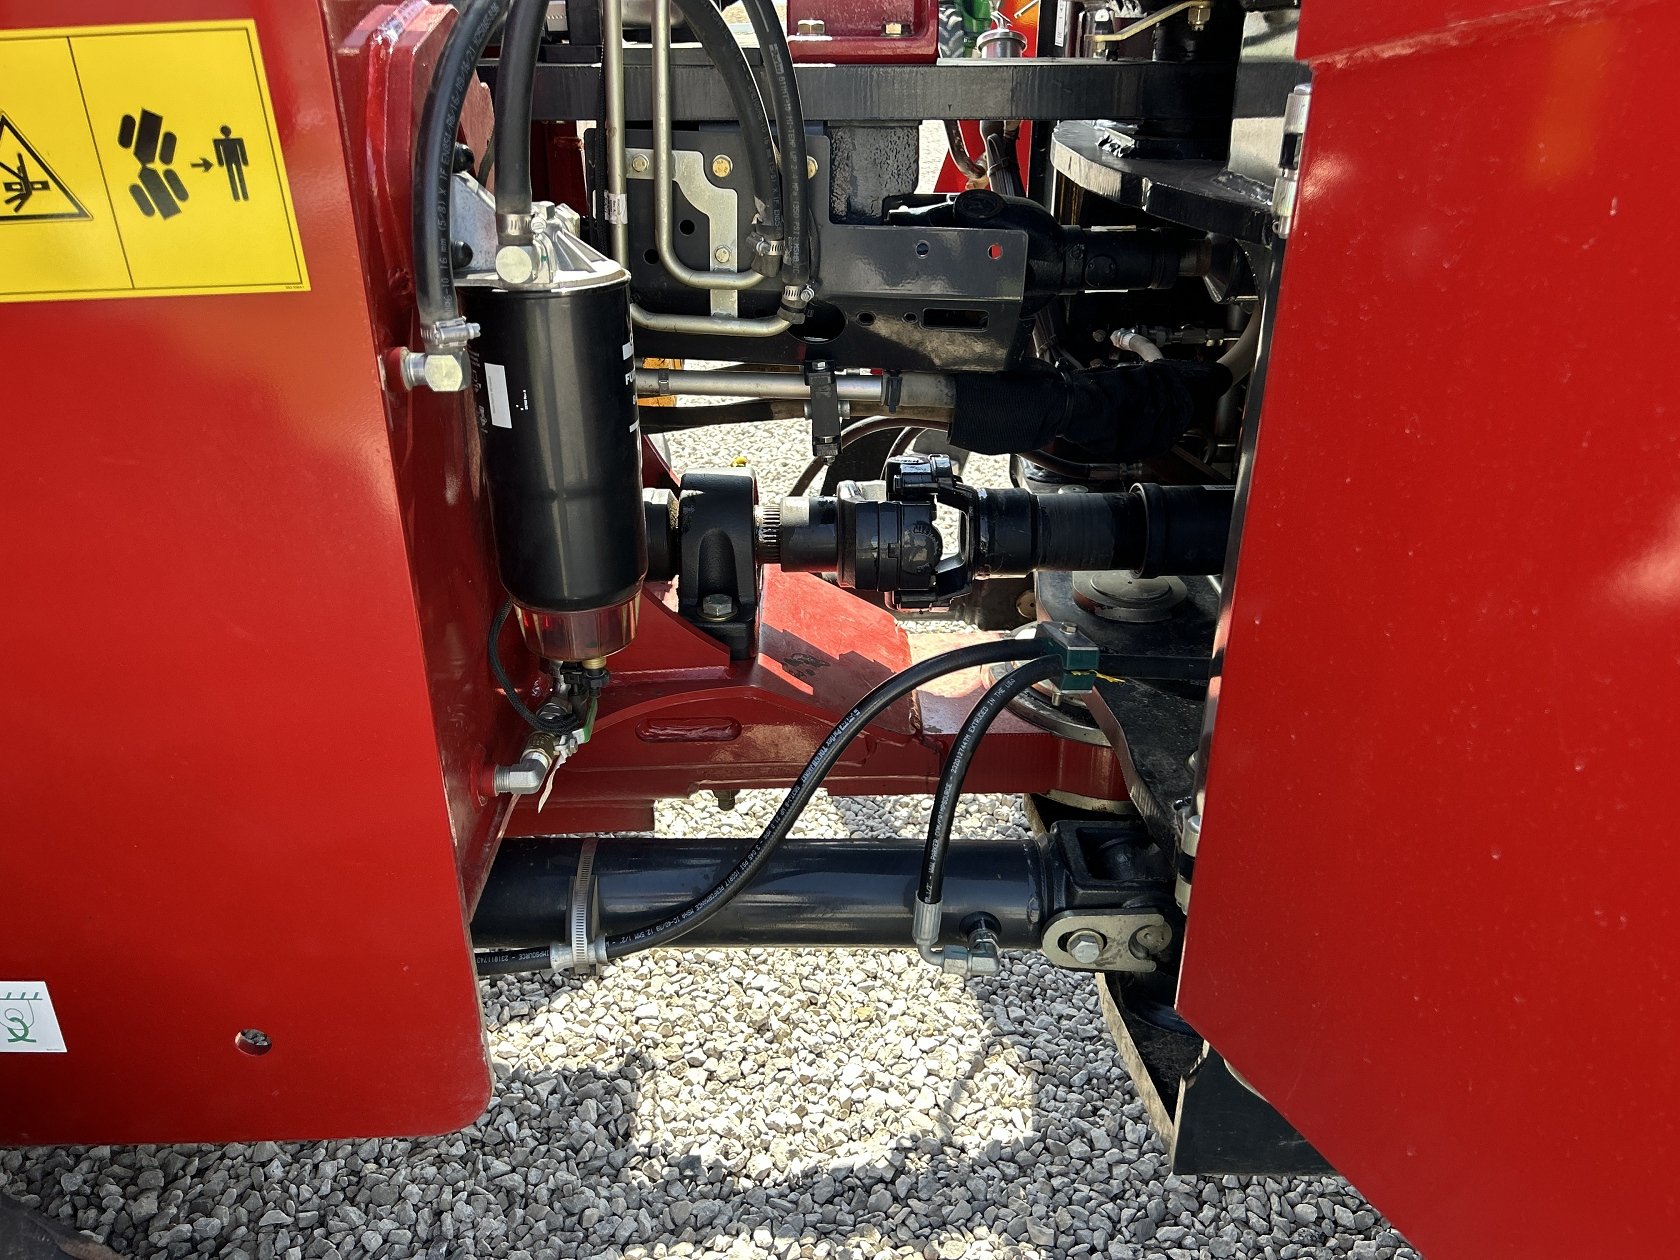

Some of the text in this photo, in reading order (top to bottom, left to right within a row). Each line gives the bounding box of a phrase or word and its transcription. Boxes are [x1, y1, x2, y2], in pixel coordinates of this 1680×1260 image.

[968, 706, 989, 733] EXTRUDED
[986, 696, 997, 707] IN
[994, 686, 1006, 698] THE
[694, 885, 725, 910] PERFORMANCE
